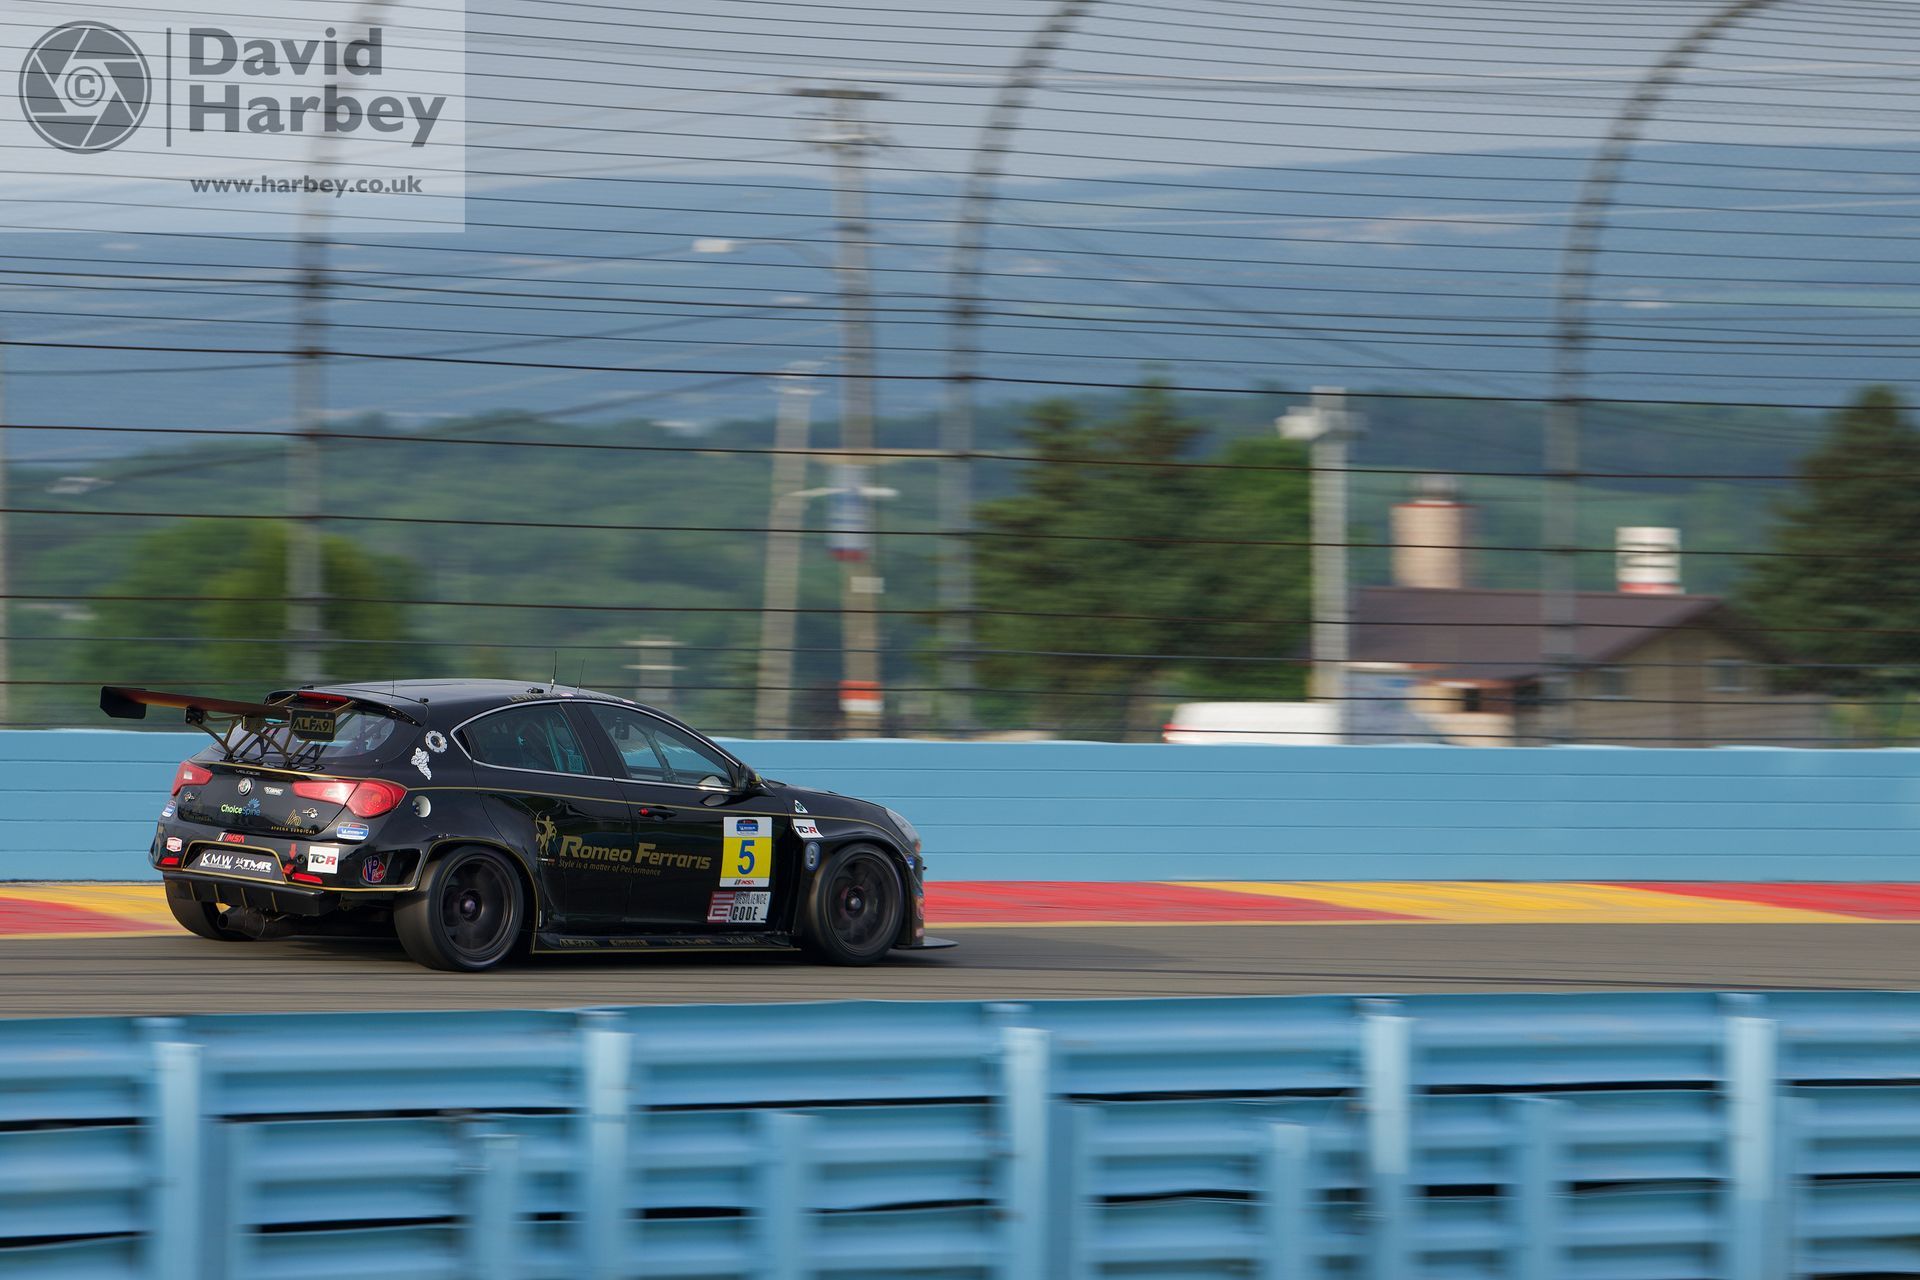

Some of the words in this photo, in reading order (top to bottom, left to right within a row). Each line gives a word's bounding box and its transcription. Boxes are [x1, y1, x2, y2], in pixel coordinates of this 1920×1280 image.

[796, 826, 817, 834] TCR
[310, 853, 337, 866] TCR
[559, 835, 632, 861] Romeo
[635, 842, 712, 870] Ferraris
[737, 839, 755, 875] 5
[202, 853, 234, 867] KMW
[242, 859, 272, 871] TMR
[558, 859, 575, 869] Style
[576, 861, 583, 869] is
[589, 863, 610, 872] matter
[611, 863, 620, 873] of
[732, 906, 758, 920] CODE
